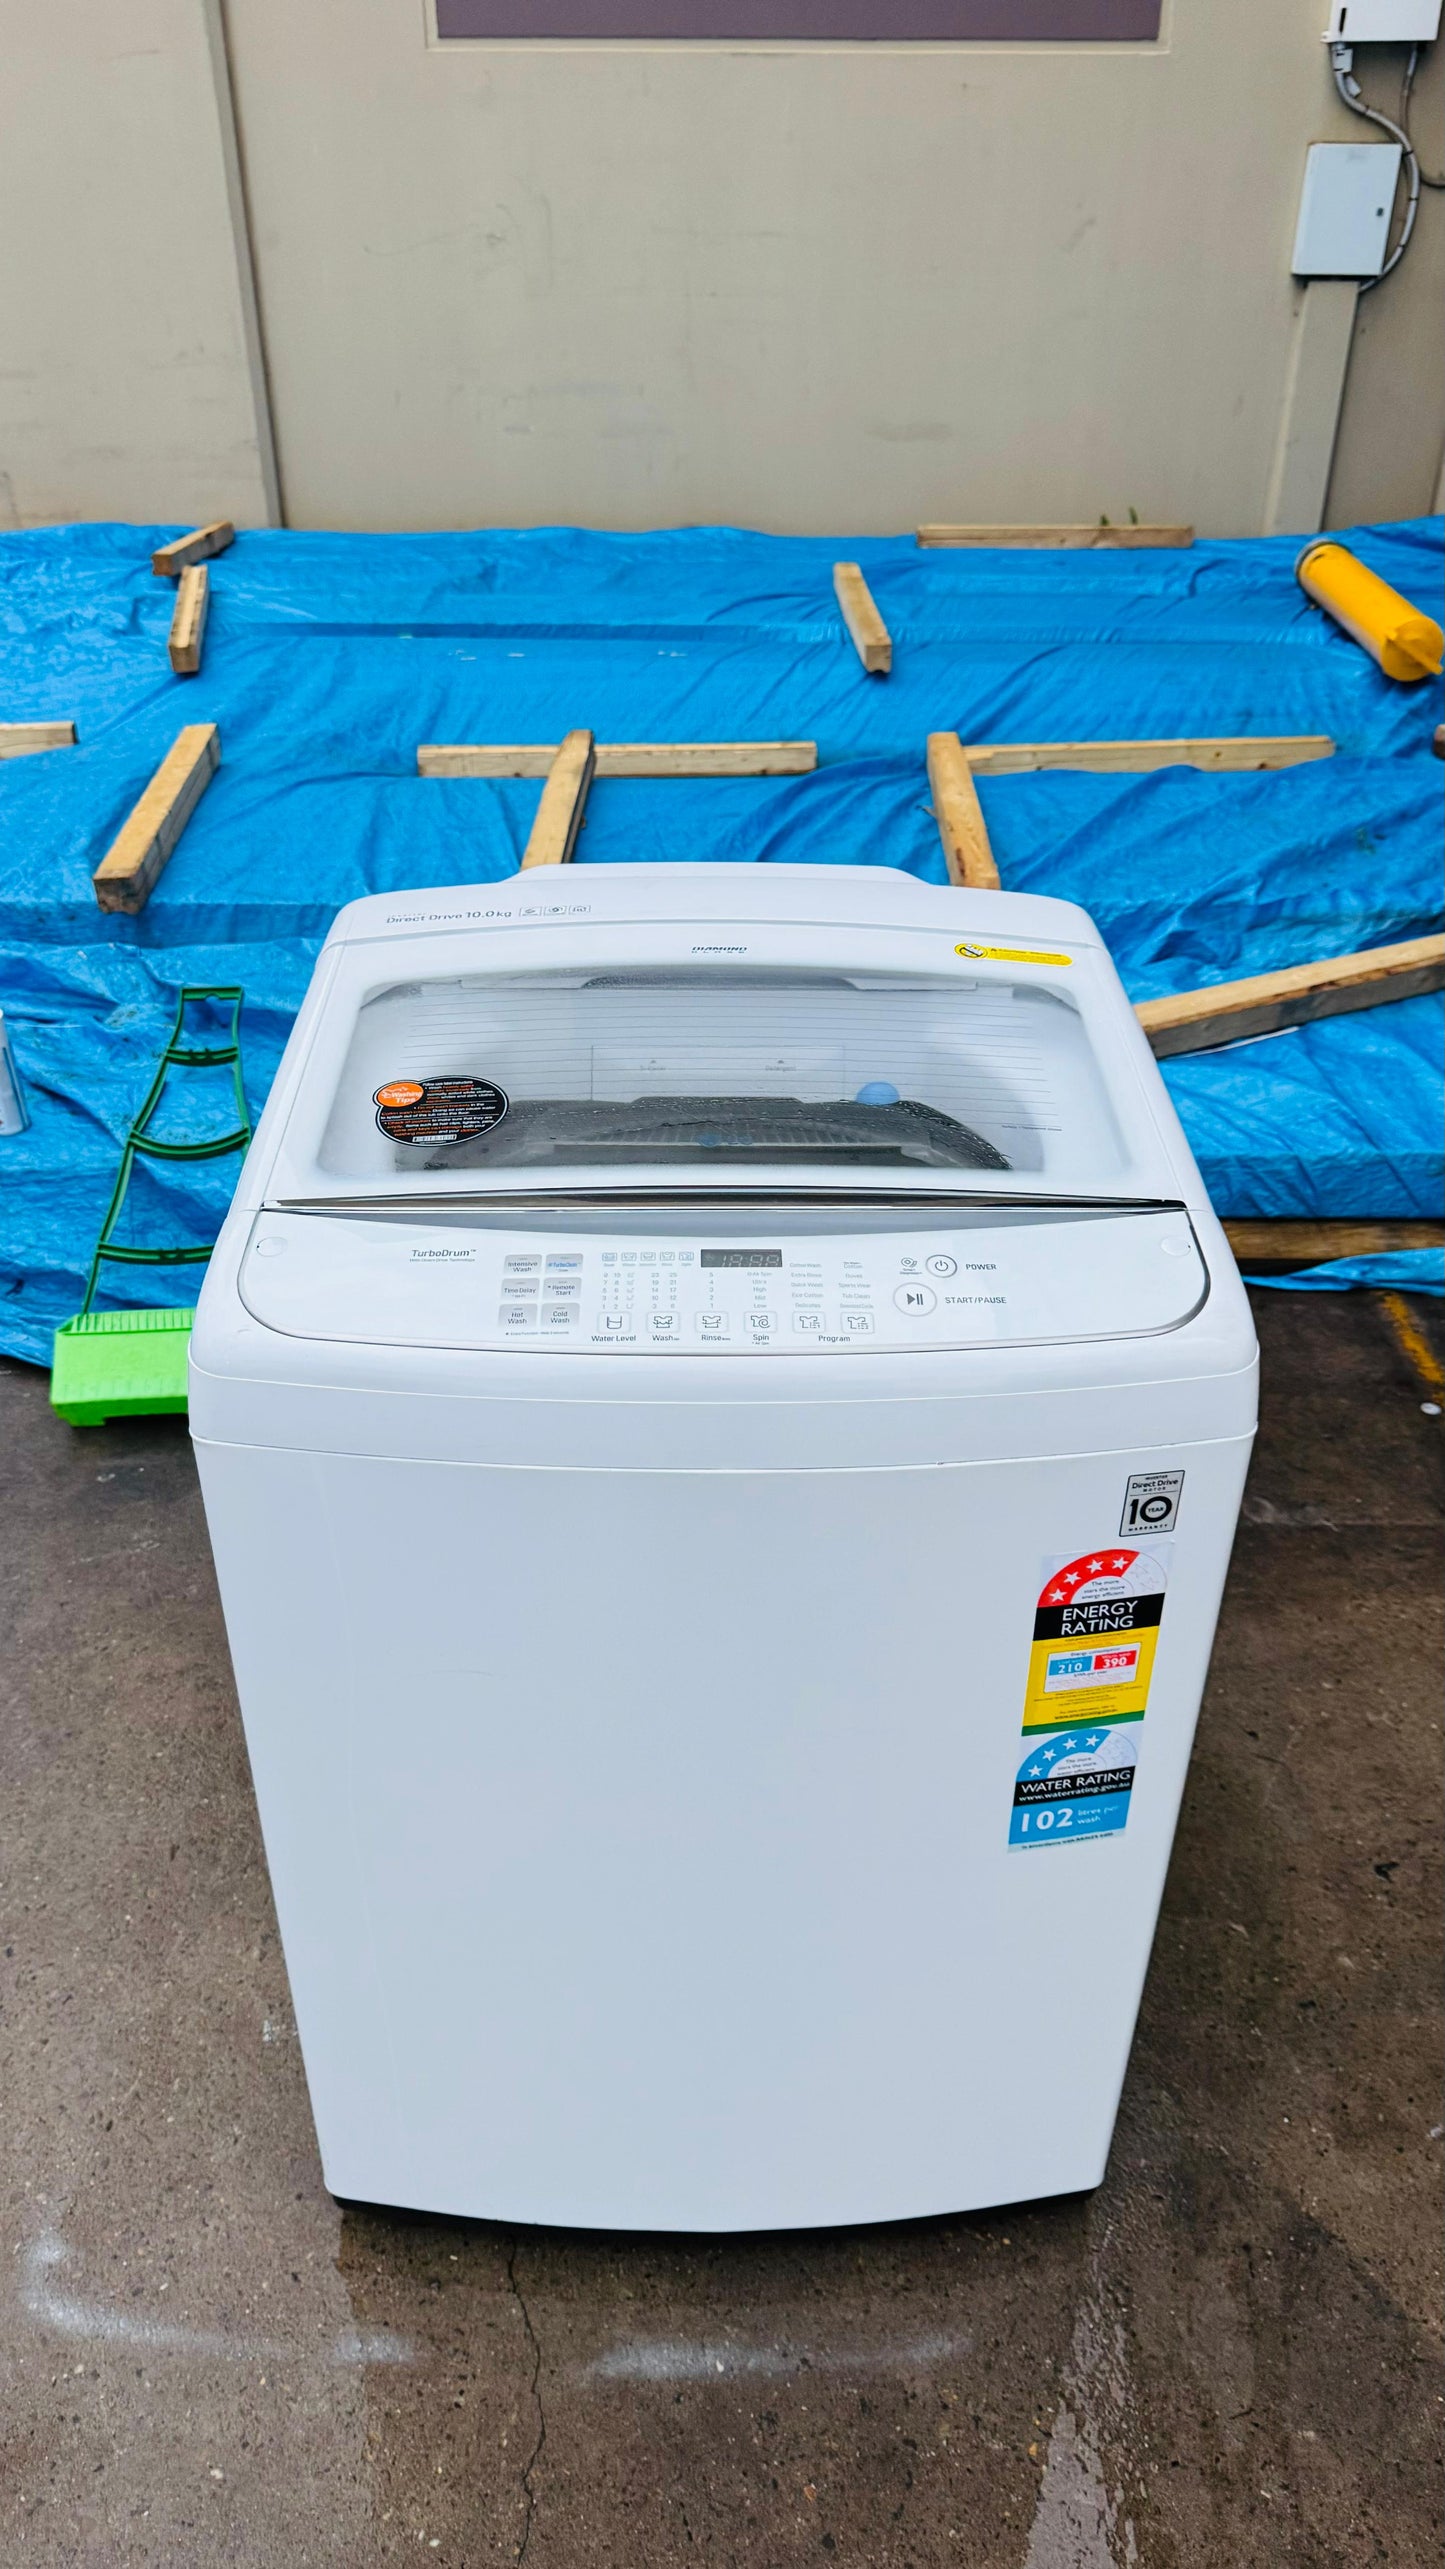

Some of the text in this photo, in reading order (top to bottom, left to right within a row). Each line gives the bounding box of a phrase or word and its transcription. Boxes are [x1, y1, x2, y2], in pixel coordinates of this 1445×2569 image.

[391, 1091, 424, 1099] Washing
[397, 1097, 417, 1105] Tips
[965, 1263, 997, 1271] POWER
[503, 1286, 537, 1294] Time Delay
[945, 1296, 1007, 1305] START/PAUSE
[552, 1310, 568, 1318] Cold
[591, 1334, 637, 1343] Water Level
[652, 1334, 674, 1342] Wash
[701, 1334, 722, 1342] Rinse
[753, 1333, 770, 1342] Spin
[818, 1334, 851, 1343] Program
[1132, 1478, 1179, 1489] Direct Drive
[1129, 1495, 1173, 1525] 10
[1062, 1600, 1138, 1622] ENERGY
[1061, 1615, 1134, 1636] RATING
[1103, 1656, 1127, 1669] 390
[1058, 1662, 1083, 1675] 210
[1021, 1770, 1131, 1794] WATER RATING
[1019, 1782, 1131, 1802] www.waterrating.gov.au
[1078, 1808, 1101, 1817] litres
[1021, 1807, 1073, 1833] 102
[1076, 1815, 1101, 1826] wash
